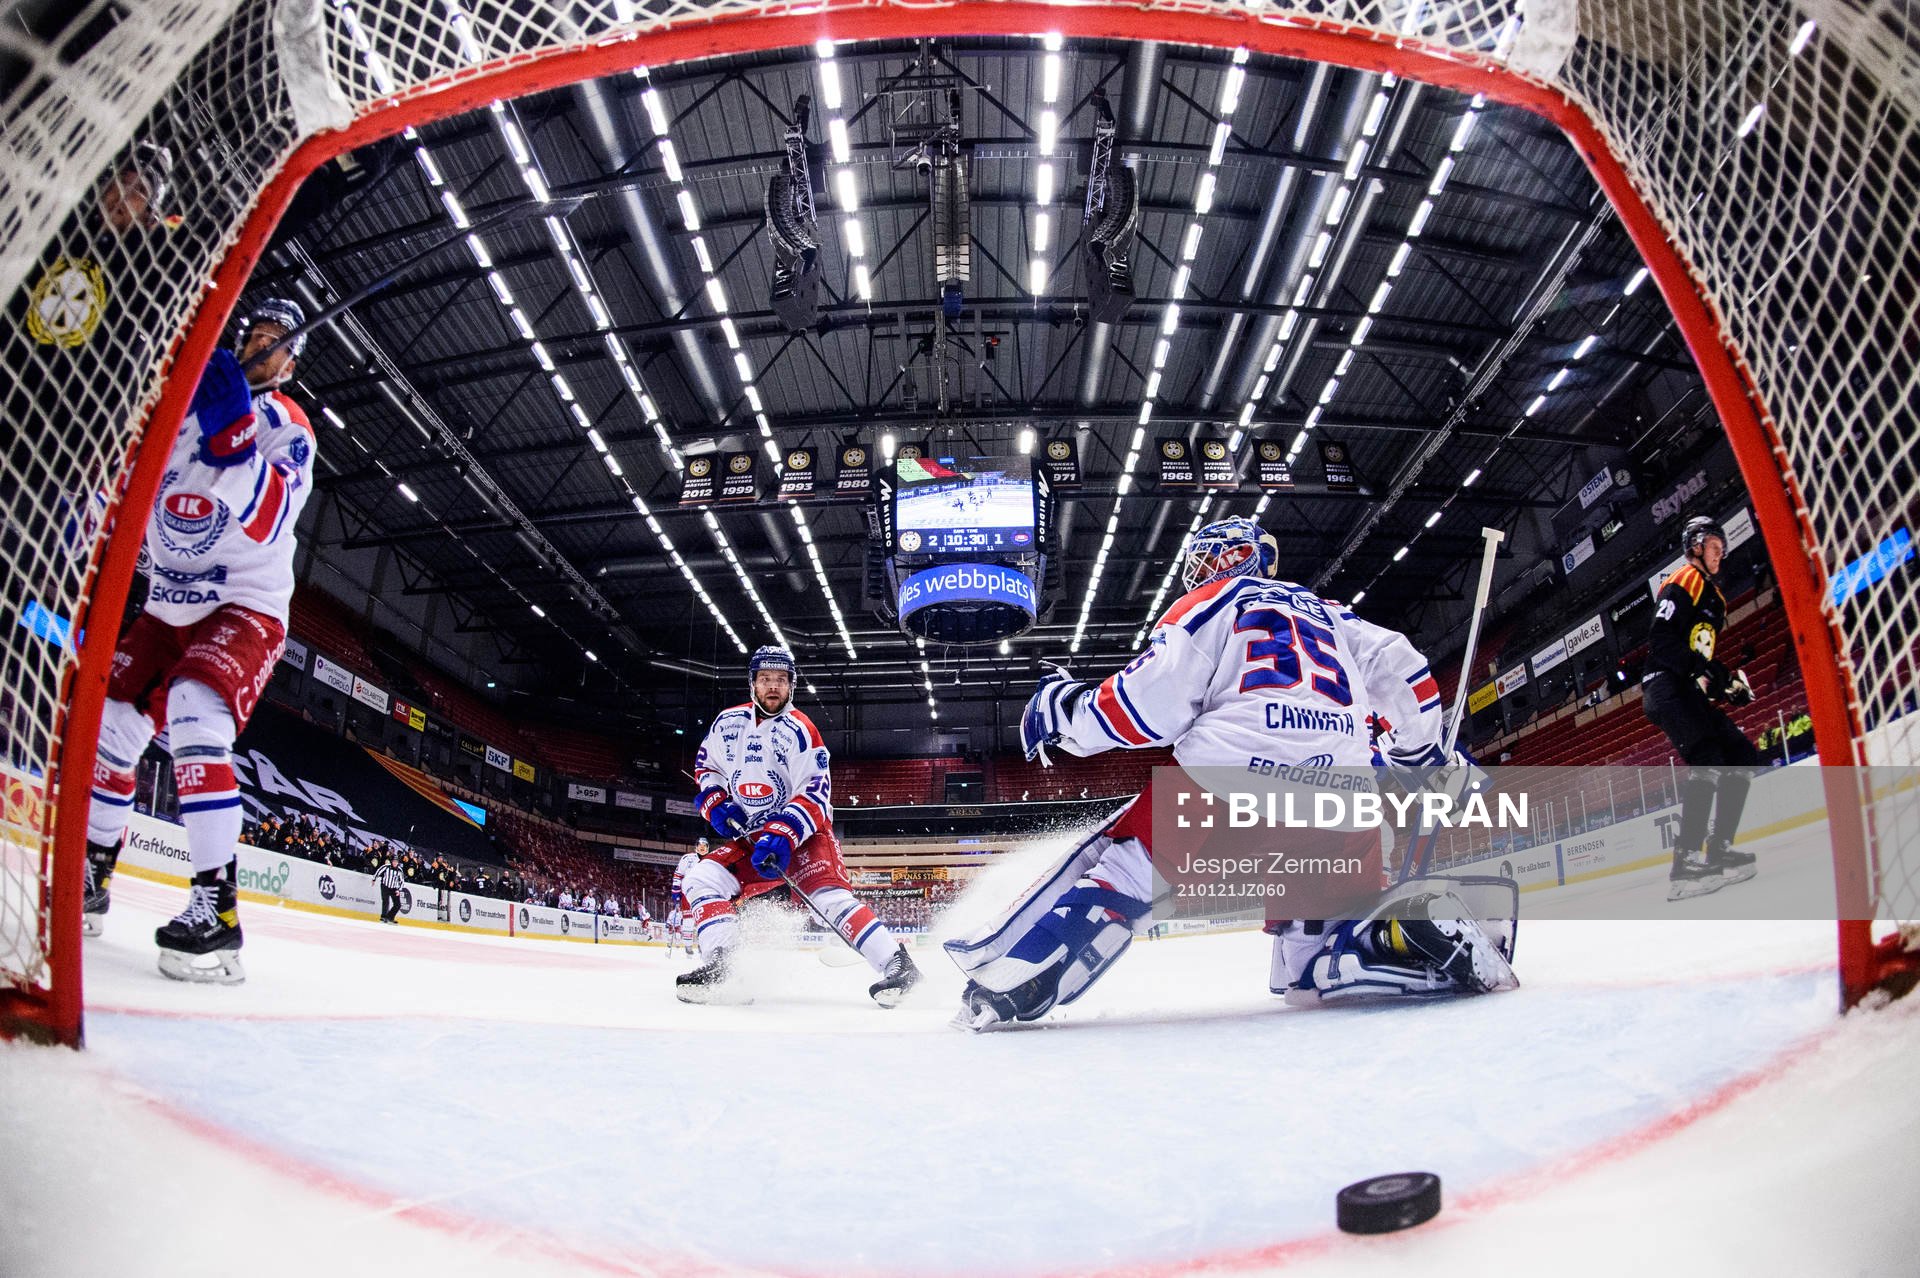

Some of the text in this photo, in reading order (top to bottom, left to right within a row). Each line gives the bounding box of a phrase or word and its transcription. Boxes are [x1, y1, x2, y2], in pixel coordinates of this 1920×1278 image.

[1053, 472, 1077, 482] 971
[1162, 472, 1193, 480] 1968
[1203, 472, 1234, 481] 1967
[1260, 473, 1291, 482] 1966
[1326, 475, 1353, 483] 1964
[780, 482, 813, 492] 1993
[837, 479, 870, 488] 1980
[1586, 470, 1608, 495] STENA
[681, 488, 713, 498] 2012
[722, 486, 754, 495] 1999
[1651, 470, 1708, 525] Skybar
[177, 497, 203, 515] IK
[928, 533, 1003, 546] 2 10:30 1
[925, 568, 1029, 600] webbplats
[151, 582, 221, 604] ŠKODA
[286, 648, 304, 664] etro
[1233, 607, 1353, 708] 35
[1265, 702, 1355, 737] CANNATA
[487, 750, 508, 766] SKF
[1246, 756, 1275, 777] EB
[583, 788, 599, 798] GSP
[745, 785, 763, 796] IK
[1566, 839, 1606, 857] BERENDSEN
[1517, 860, 1551, 875] För alla barn
[238, 867, 279, 893] endo
[320, 881, 334, 893] ISS
[885, 888, 924, 897] Support
[416, 899, 426, 908] För
